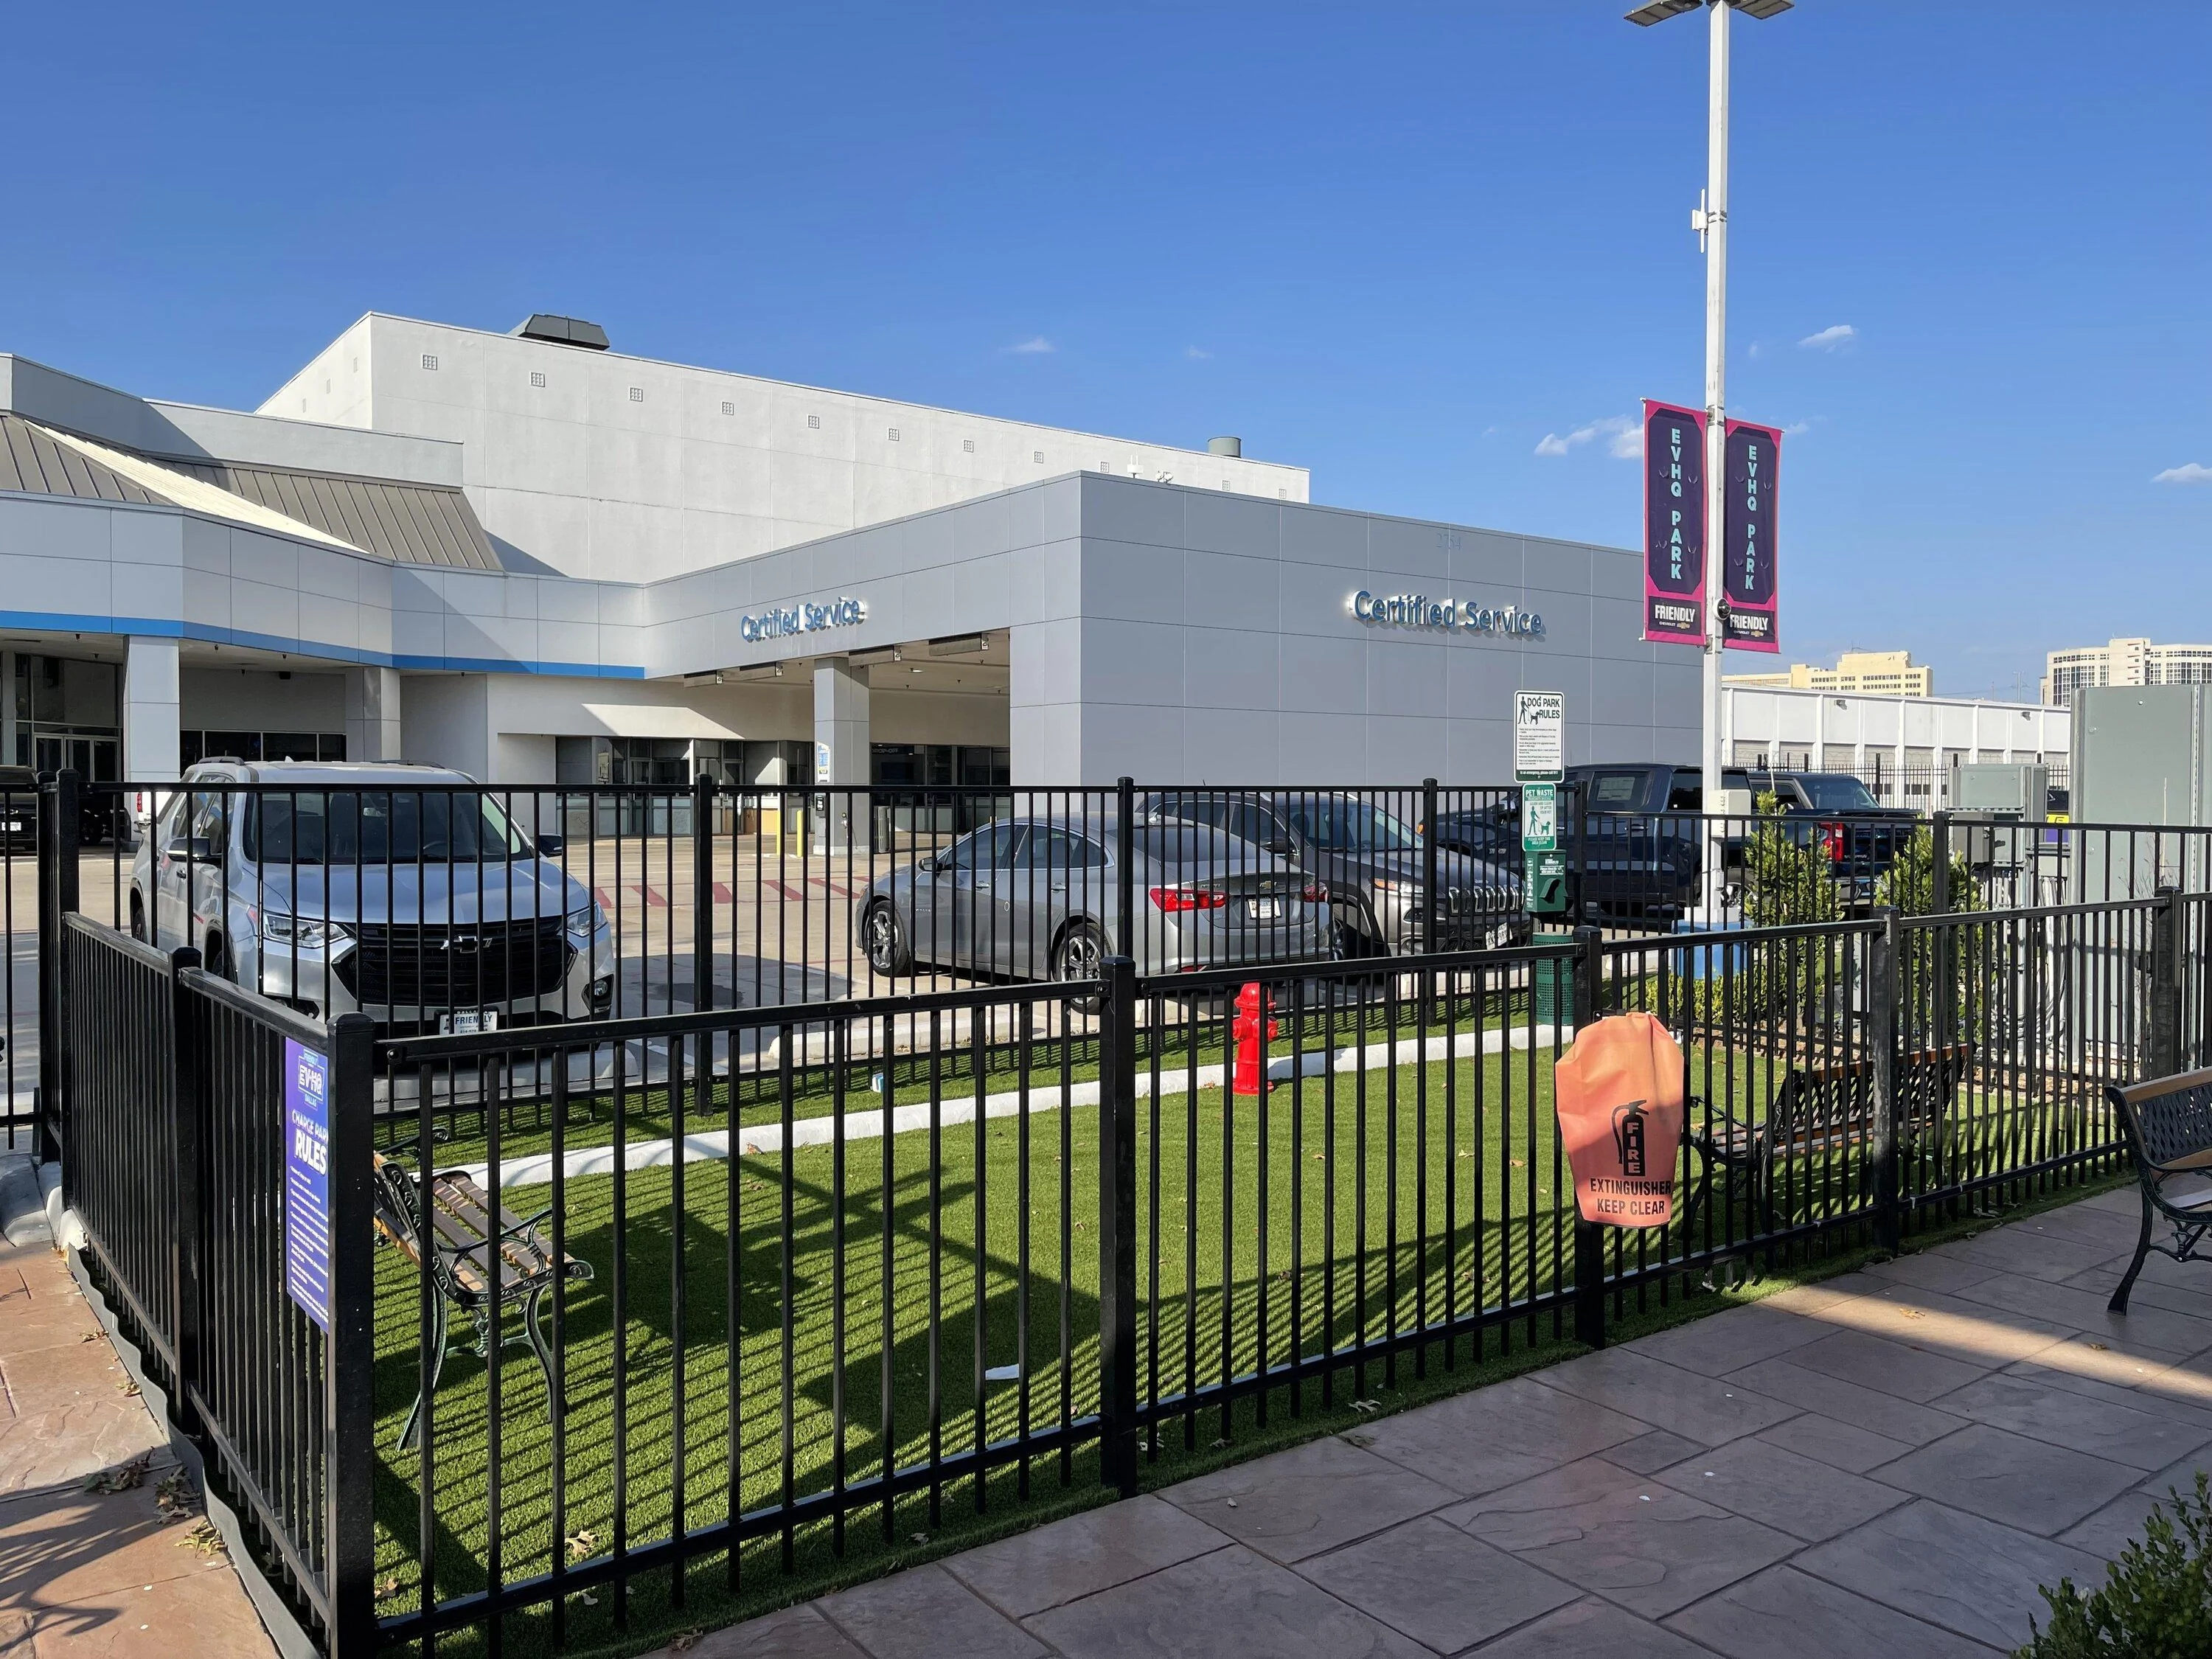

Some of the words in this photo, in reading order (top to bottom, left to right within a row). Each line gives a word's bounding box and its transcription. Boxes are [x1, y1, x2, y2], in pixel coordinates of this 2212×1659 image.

[1671, 428, 1682, 498] EVHQ
[1747, 445, 1758, 512] EVHQ
[1670, 510, 1682, 580] PARK
[1745, 524, 1756, 591] PARK
[741, 604, 804, 643] Certified
[804, 596, 867, 632] Service
[1350, 590, 1456, 628] Certified
[1464, 601, 1543, 636] Service
[1655, 605, 1695, 622] FRIENDLY
[1729, 614, 1769, 630] FRIENDLY
[1527, 698, 1542, 707] DOG
[1543, 698, 1560, 708] PARK
[1539, 709, 1560, 719] RULES
[455, 1015, 493, 1025] FRIENLY
[292, 1109, 314, 1135] CHARGE
[295, 1128, 327, 1176] RULES
[1627, 1121, 1641, 1174] FIRE
[1590, 1178, 1672, 1195] EXTINGUISHER
[1596, 1197, 1626, 1215] KEEP
[1630, 1200, 1665, 1216] CLEAR
